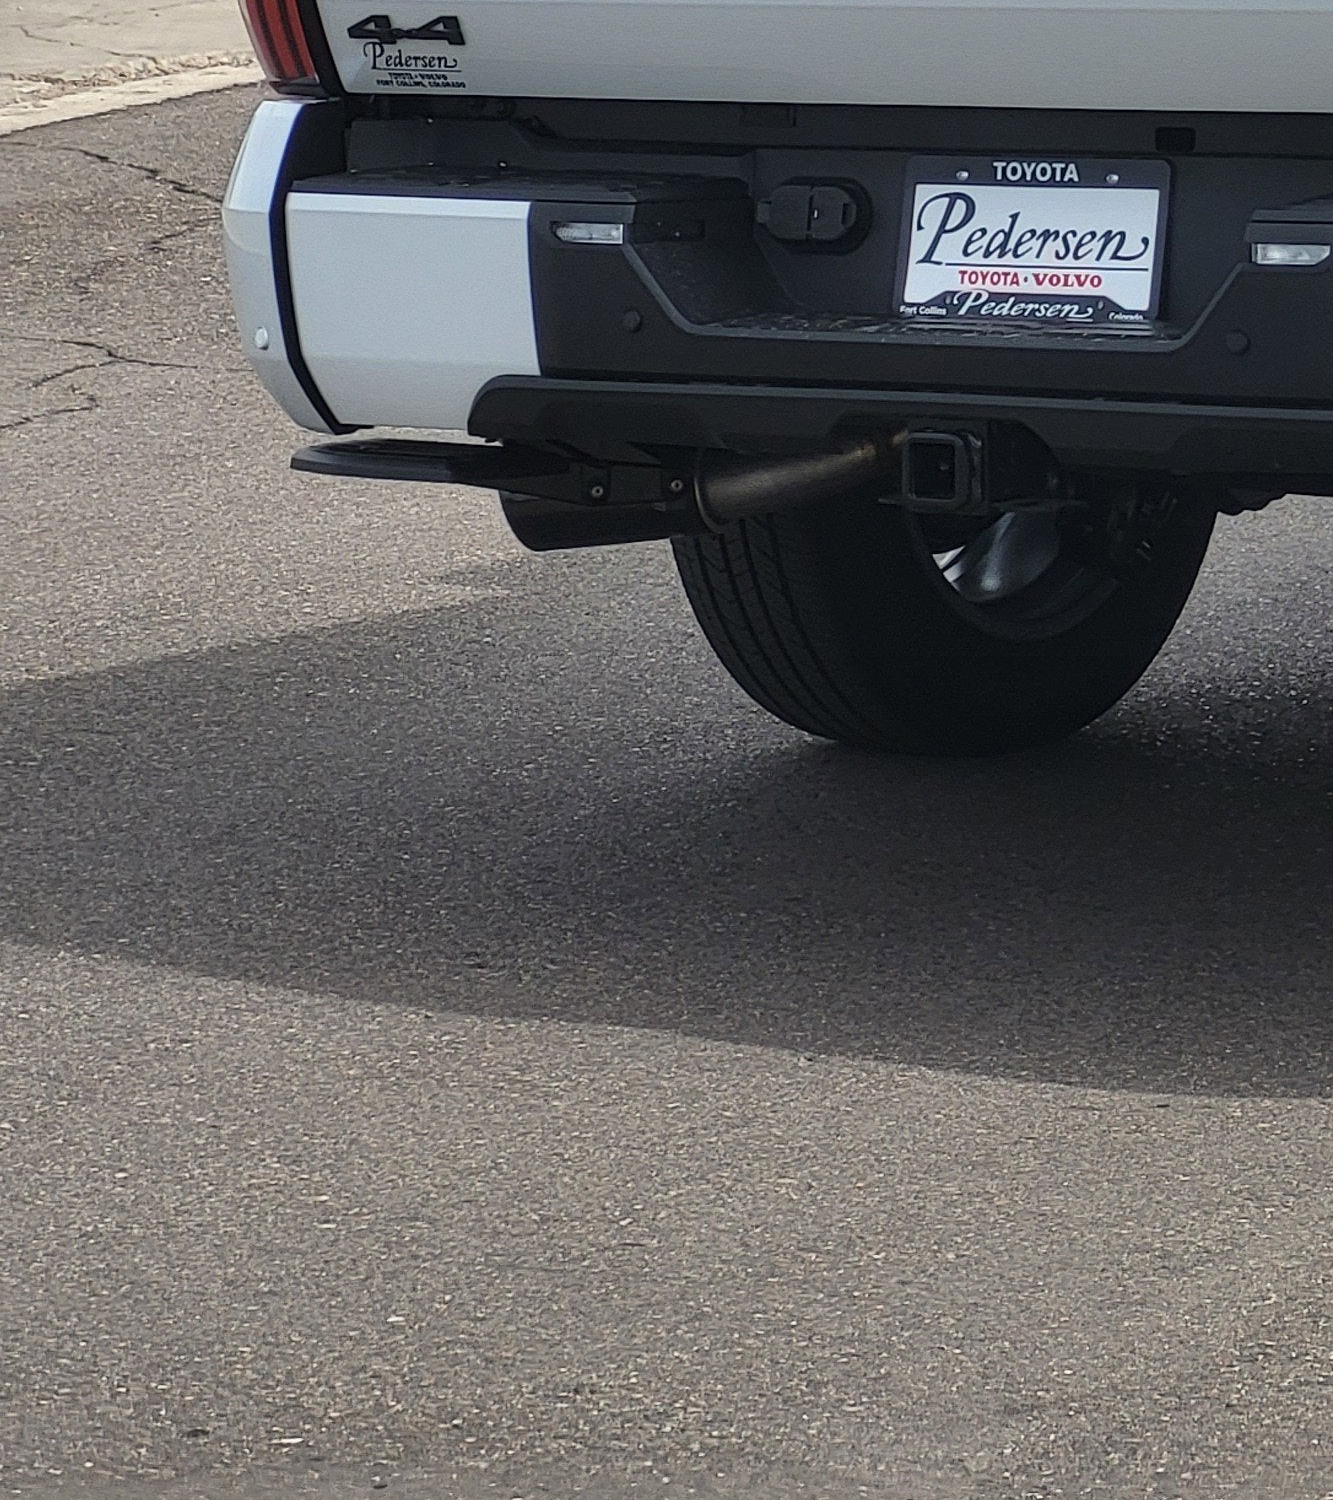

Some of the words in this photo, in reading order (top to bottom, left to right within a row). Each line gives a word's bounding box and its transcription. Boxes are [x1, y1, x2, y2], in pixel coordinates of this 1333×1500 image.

[363, 41, 459, 70] Pedersen
[993, 161, 1080, 183] TOYOTA
[915, 191, 1150, 266] Pedersen
[958, 270, 1021, 286] TOYOTA
[1032, 272, 1103, 288] VOLVO
[919, 305, 947, 316] Collins
[953, 289, 1094, 320] Pedersen
